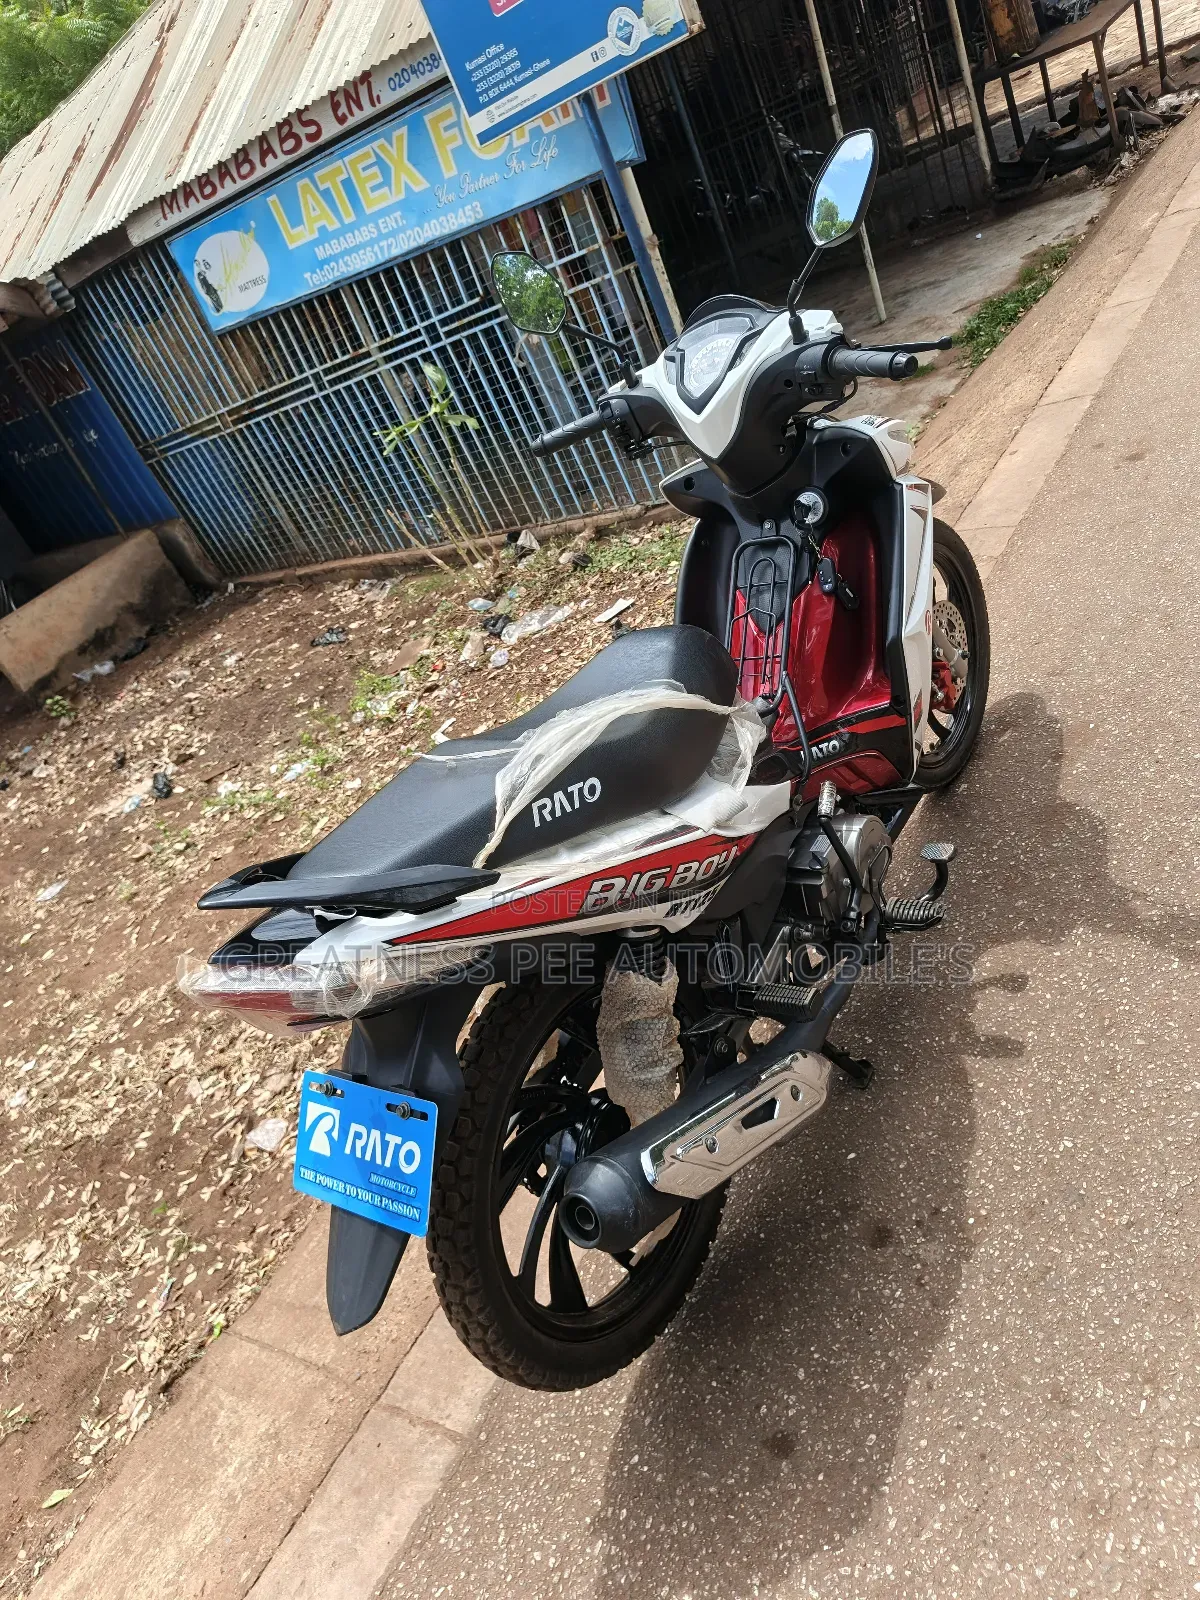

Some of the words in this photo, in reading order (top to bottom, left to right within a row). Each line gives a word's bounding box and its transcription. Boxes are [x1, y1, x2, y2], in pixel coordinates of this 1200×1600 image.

[465, 52, 487, 71] Kumasi
[485, 43, 505, 59] Office
[159, 103, 324, 221] MABABABS
[330, 70, 383, 127] ENT.
[459, 172, 500, 197] Partner
[503, 149, 527, 180] For
[530, 134, 559, 171] Life
[266, 126, 431, 250] LATEX
[314, 222, 378, 261] MABABABS
[378, 210, 407, 235] ENT.
[238, 275, 267, 294] MATTRESS
[532, 777, 602, 828] RATO
[579, 866, 673, 915] BIG
[669, 845, 739, 888] BOY
[344, 1122, 421, 1174] RATO
[300, 1166, 316, 1182] THE
[316, 1171, 345, 1194] POWER
[346, 1184, 358, 1198] TO
[357, 1188, 381, 1209] YOUR
[381, 1195, 422, 1222] PASSION
[368, 1172, 417, 1198] MOTORCYCLE
